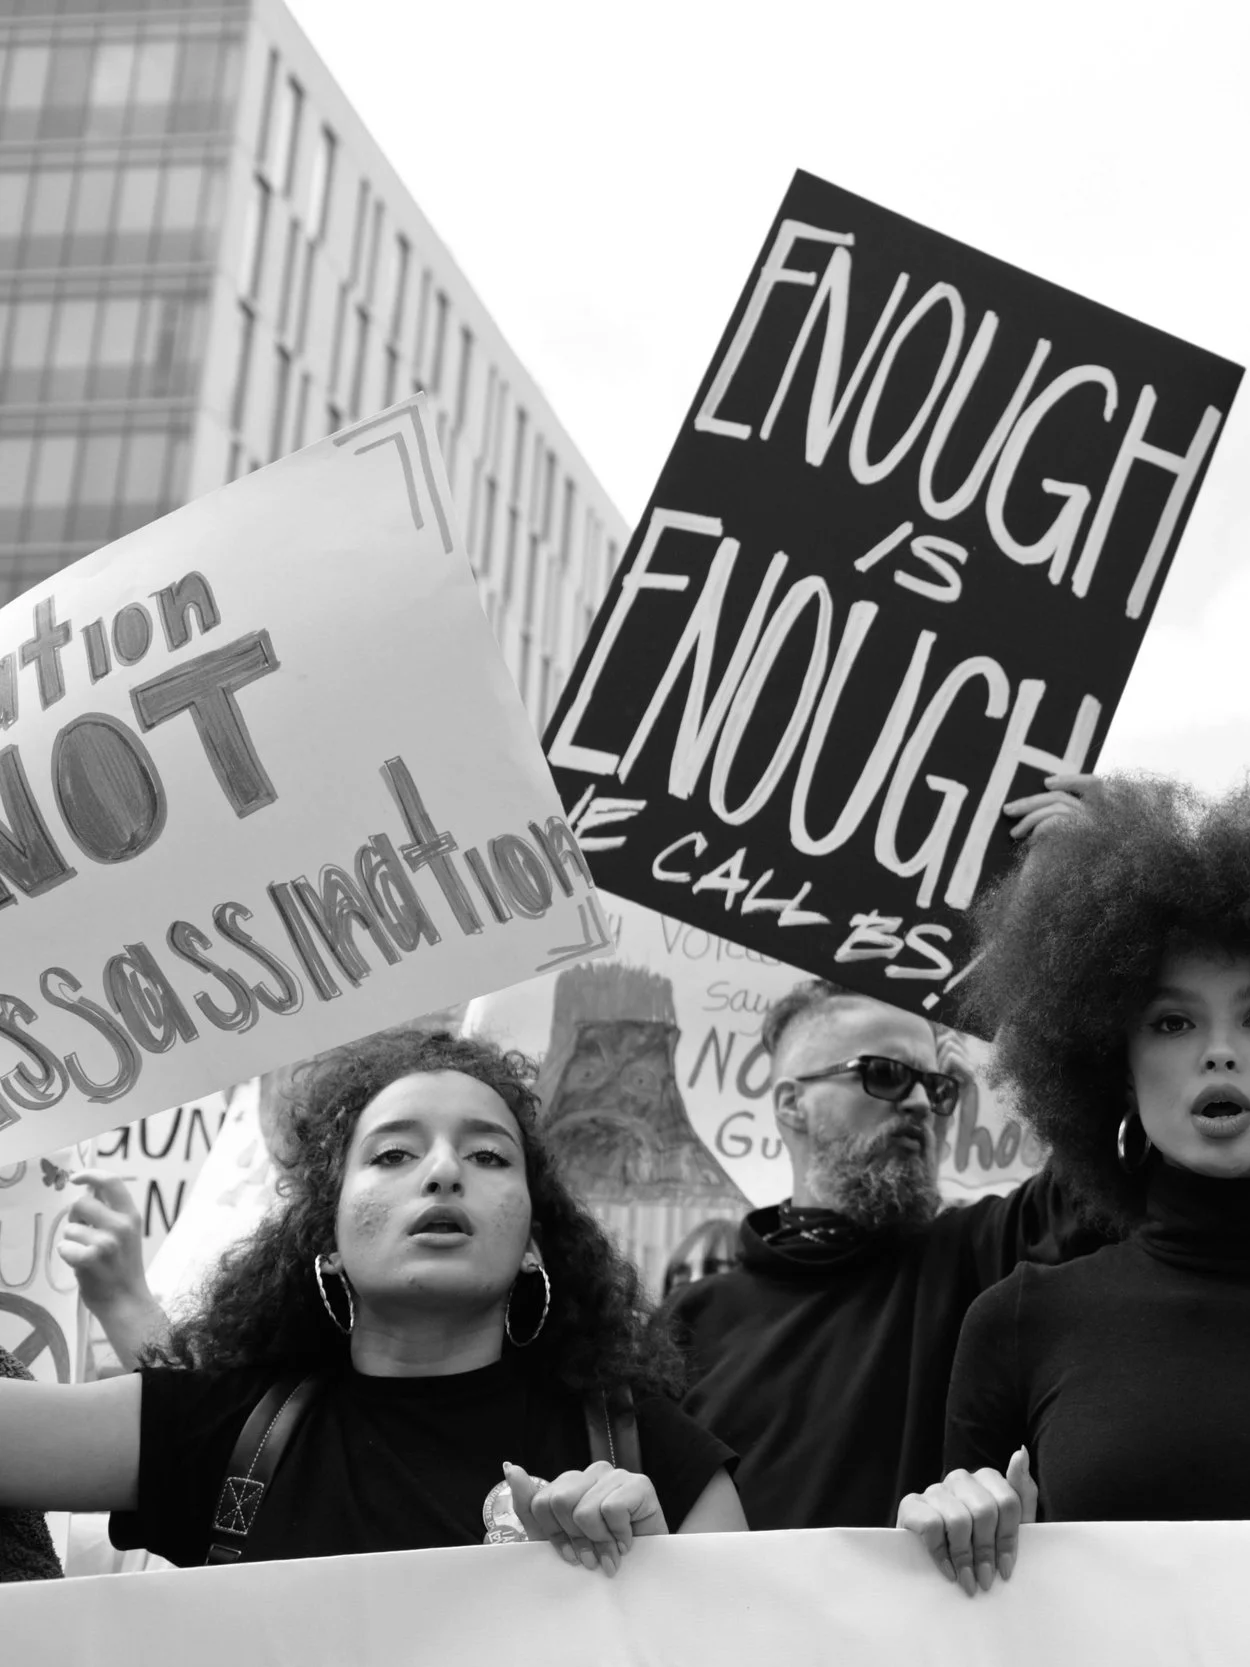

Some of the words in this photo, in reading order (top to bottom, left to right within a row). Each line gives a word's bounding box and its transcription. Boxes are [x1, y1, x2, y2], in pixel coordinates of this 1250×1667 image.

[695, 219, 1222, 620] ENOUGH
[854, 521, 968, 602] IS
[547, 507, 1102, 909] ENOUGH
[651, 831, 832, 926] CALL
[0, 755, 594, 1131] ssassination
